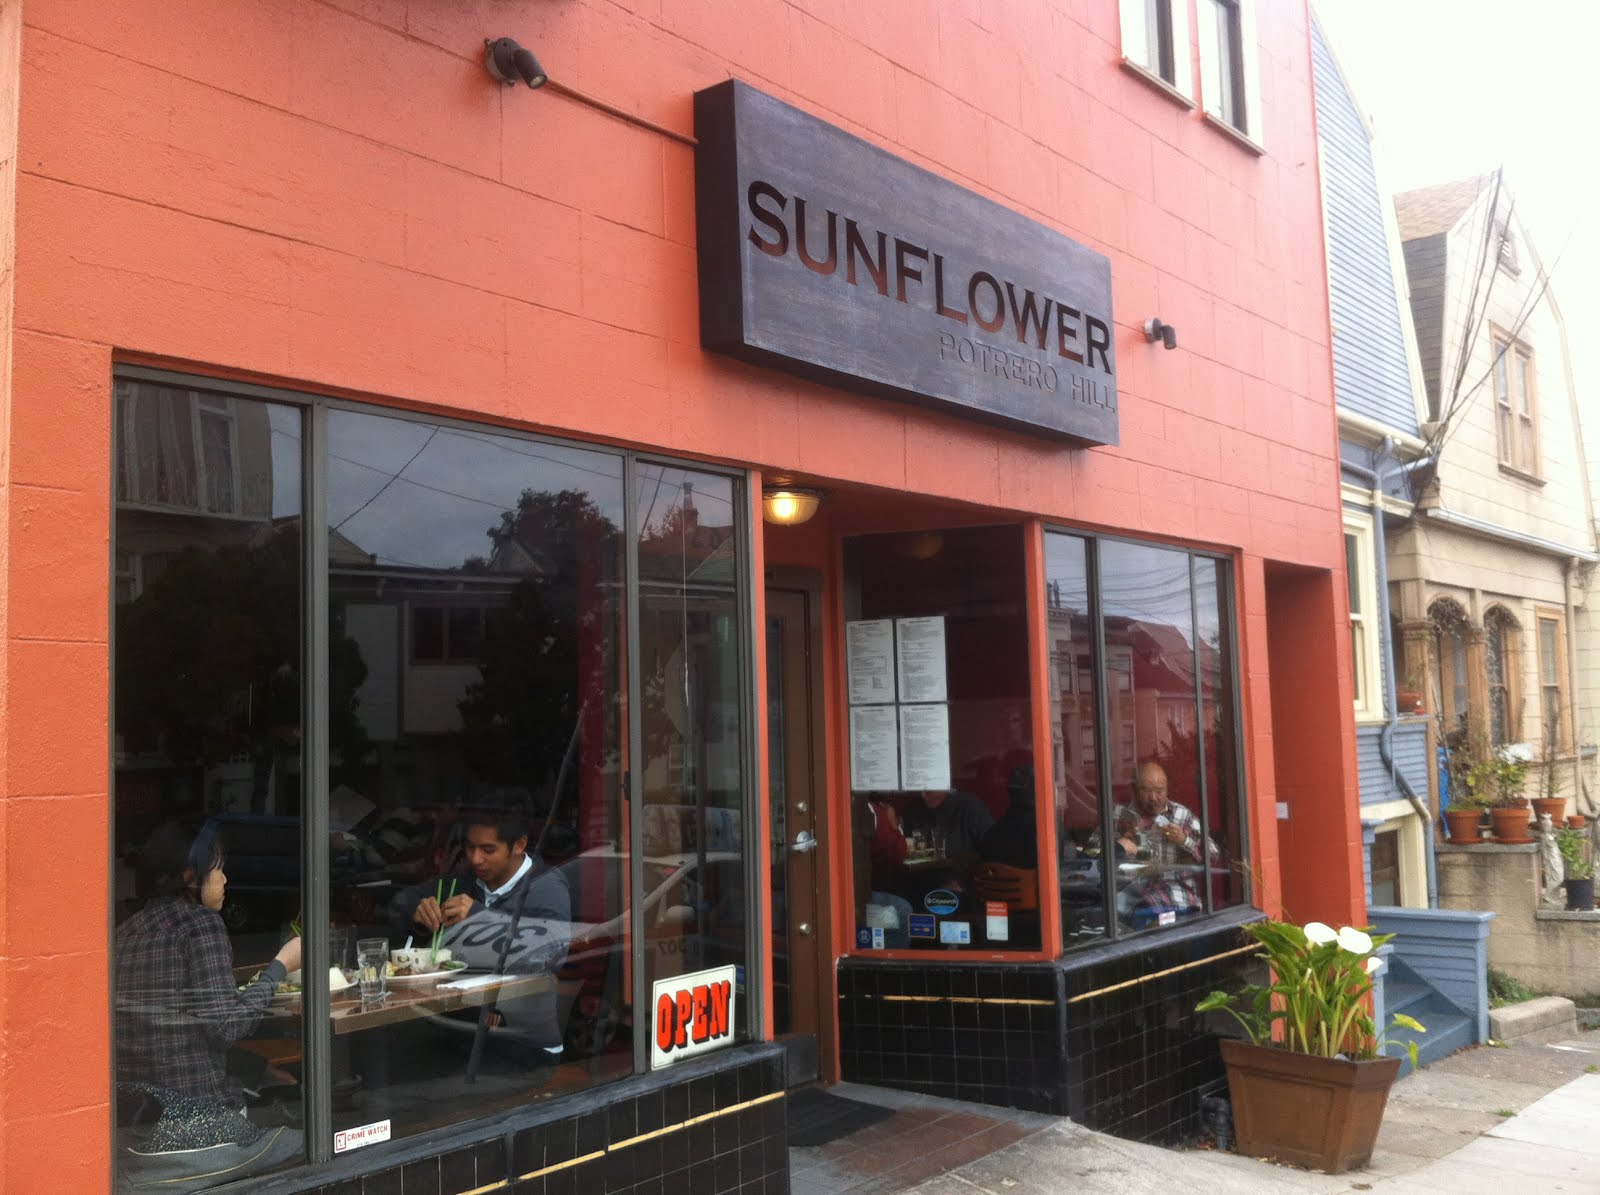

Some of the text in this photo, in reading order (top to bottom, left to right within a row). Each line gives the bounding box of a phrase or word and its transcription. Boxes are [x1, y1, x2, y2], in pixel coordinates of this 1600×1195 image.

[747, 180, 1112, 375] SUNFLOWER
[936, 329, 1115, 413] POTRERO HILL
[656, 980, 731, 1053] OPEN
[347, 1130, 366, 1142] CRIME
[367, 1124, 388, 1136] WATCH
